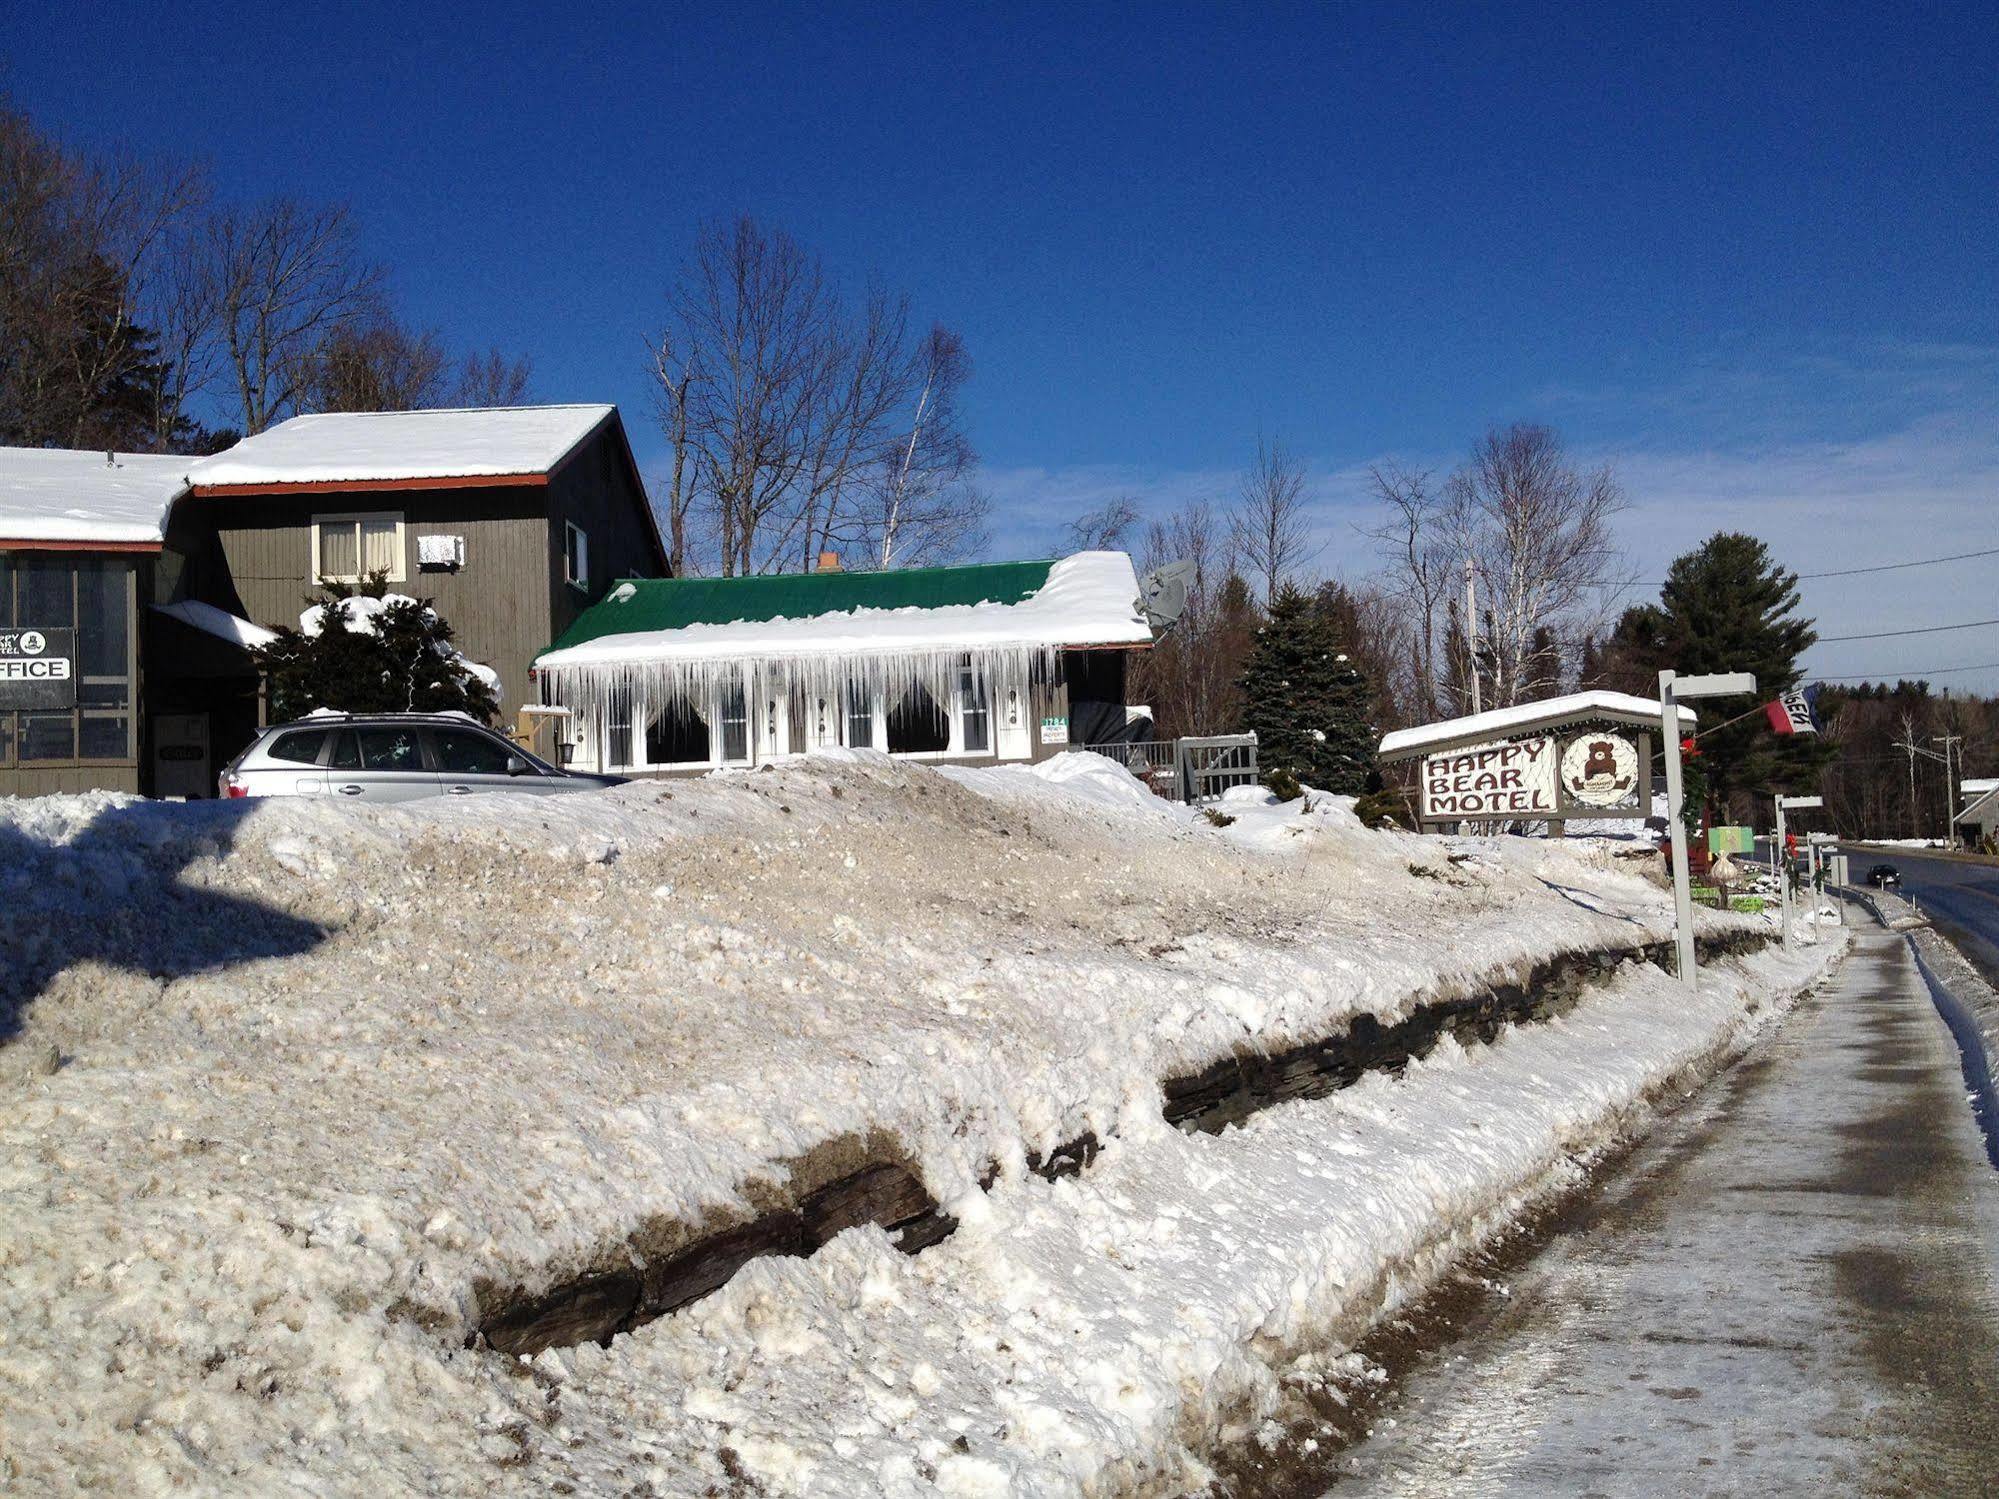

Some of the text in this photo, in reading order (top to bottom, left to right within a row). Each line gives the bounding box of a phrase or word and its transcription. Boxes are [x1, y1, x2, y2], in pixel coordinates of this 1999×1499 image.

[1045, 718, 1065, 727] 1784
[1428, 740, 1546, 776] HAPPY
[1429, 769, 1523, 794] BEAR
[1430, 789, 1550, 812] MOTEL
